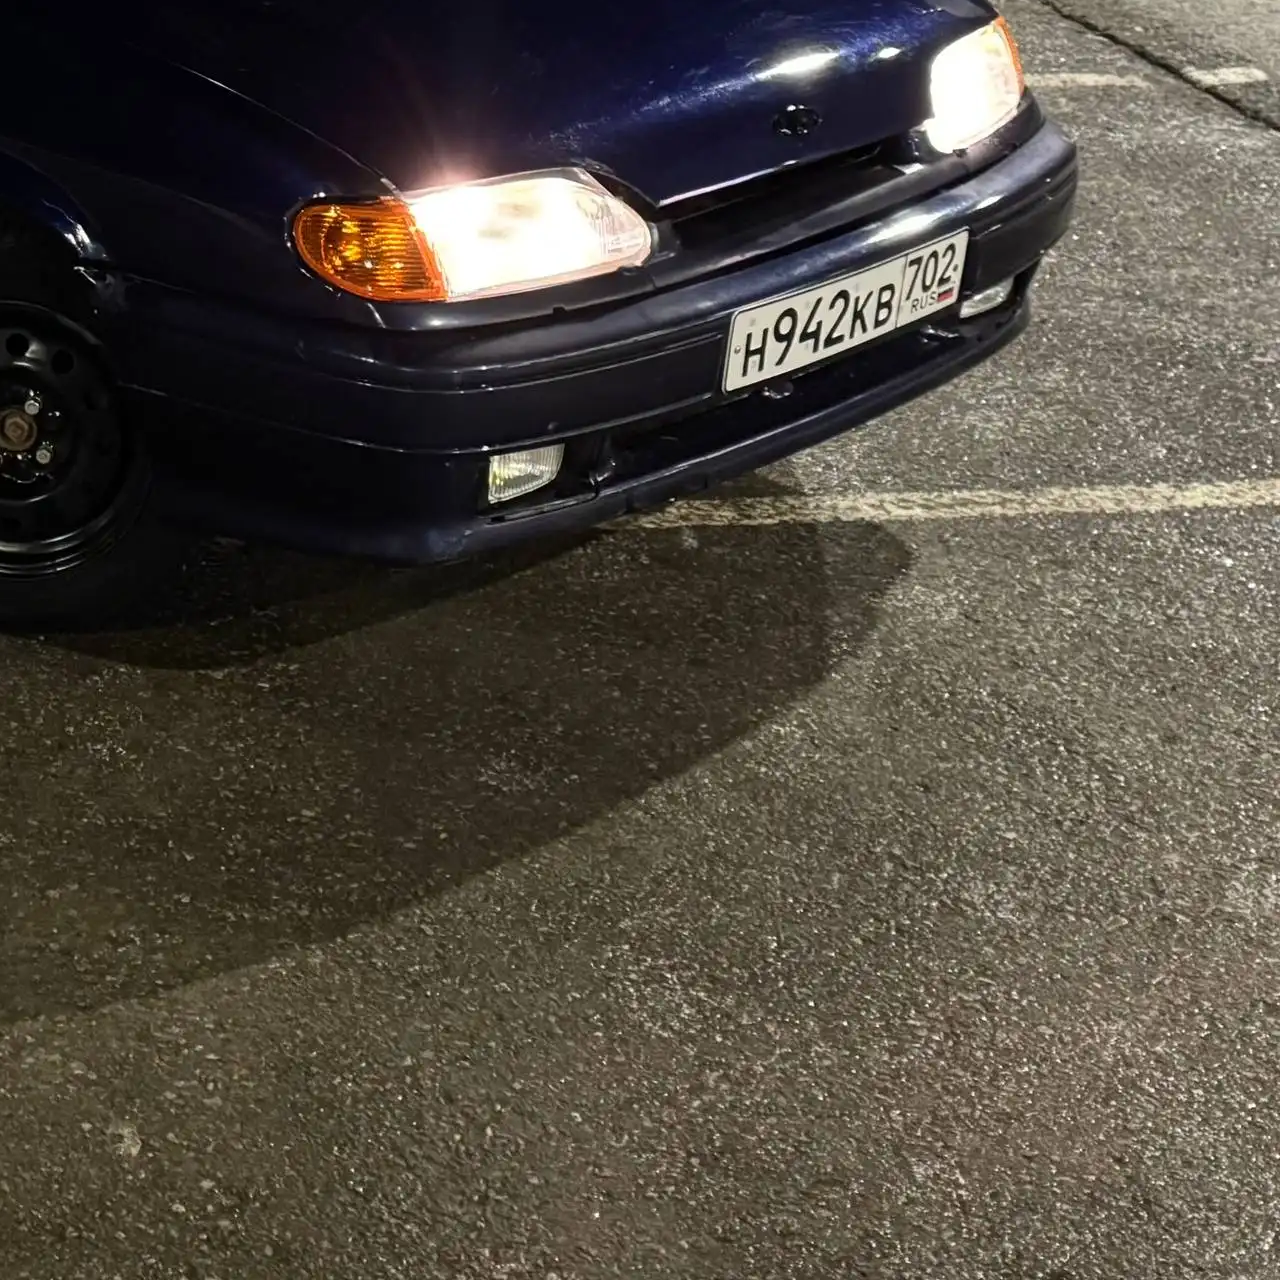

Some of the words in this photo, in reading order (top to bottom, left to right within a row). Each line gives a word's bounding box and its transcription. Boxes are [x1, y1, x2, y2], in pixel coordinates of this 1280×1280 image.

[741, 283, 896, 377] Н942КВ
[905, 242, 957, 302] 702
[910, 291, 939, 314] RUS
